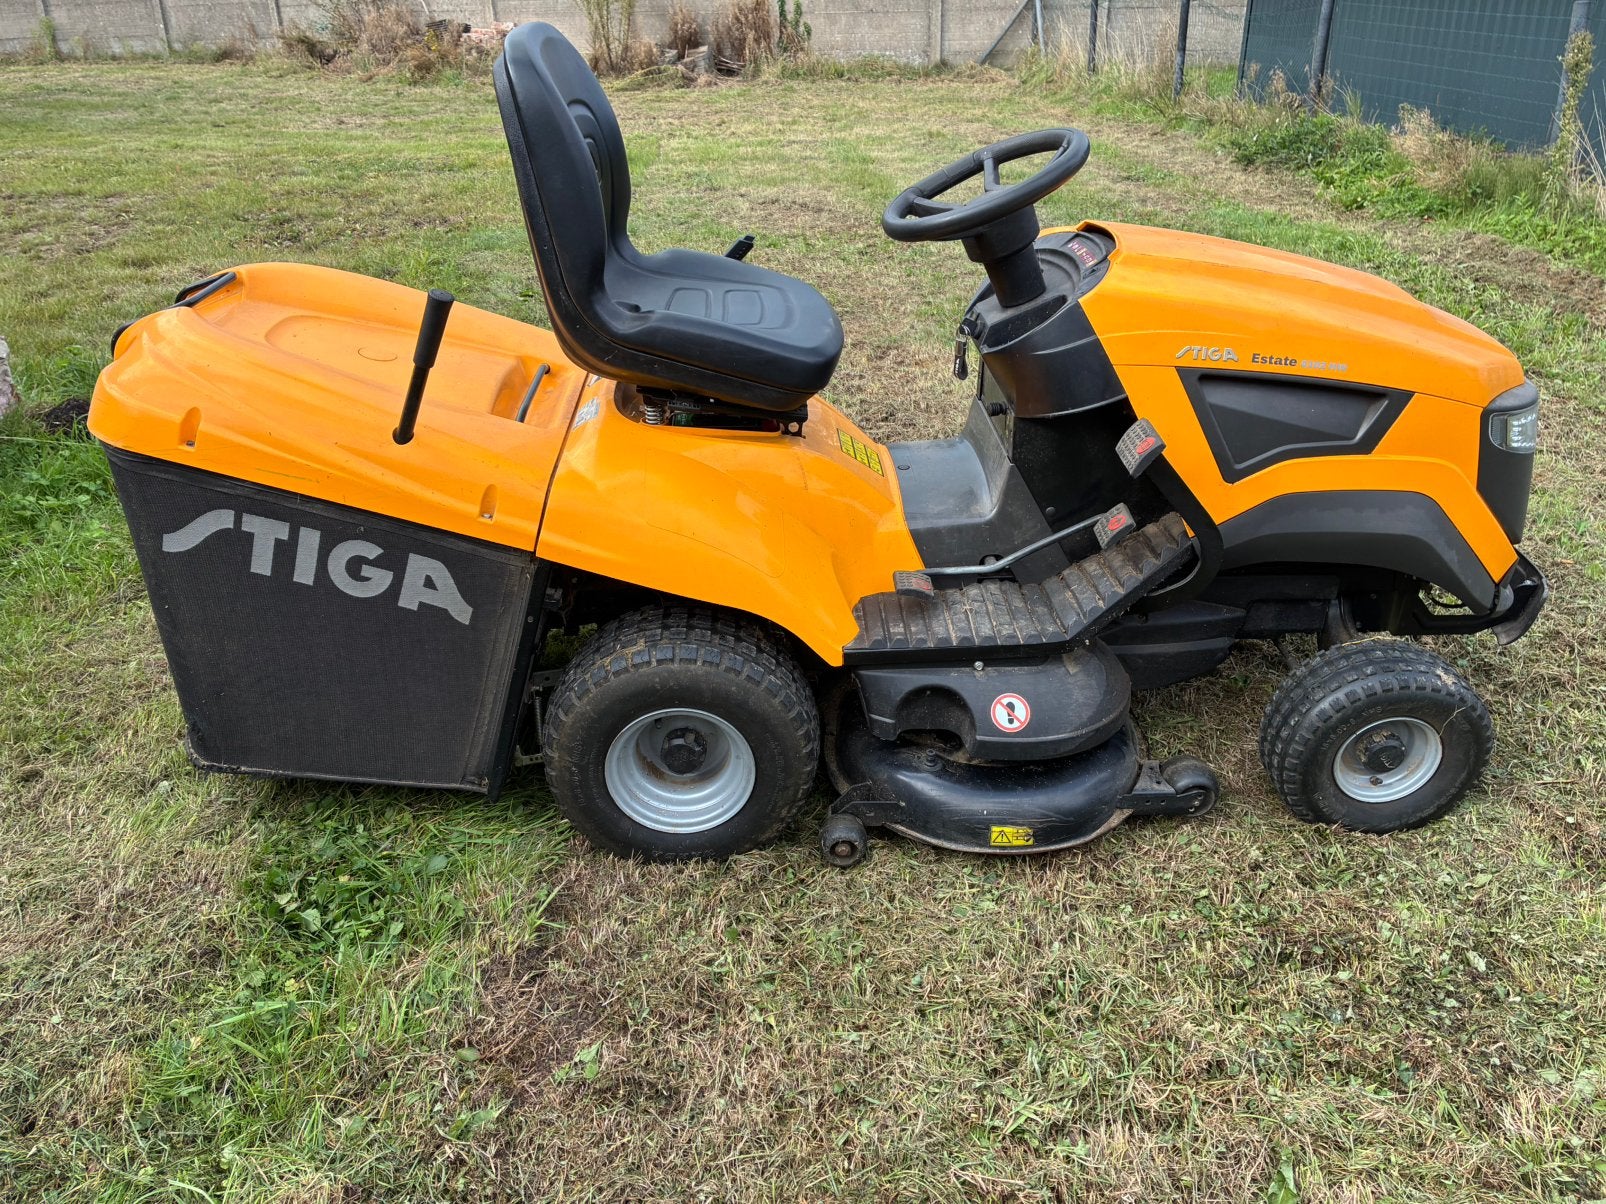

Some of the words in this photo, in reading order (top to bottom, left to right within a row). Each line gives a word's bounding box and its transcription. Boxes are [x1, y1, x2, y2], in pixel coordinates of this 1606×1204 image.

[1175, 345, 1239, 362] STIGA
[1251, 353, 1297, 367] Estate
[162, 509, 473, 625] STIGA
